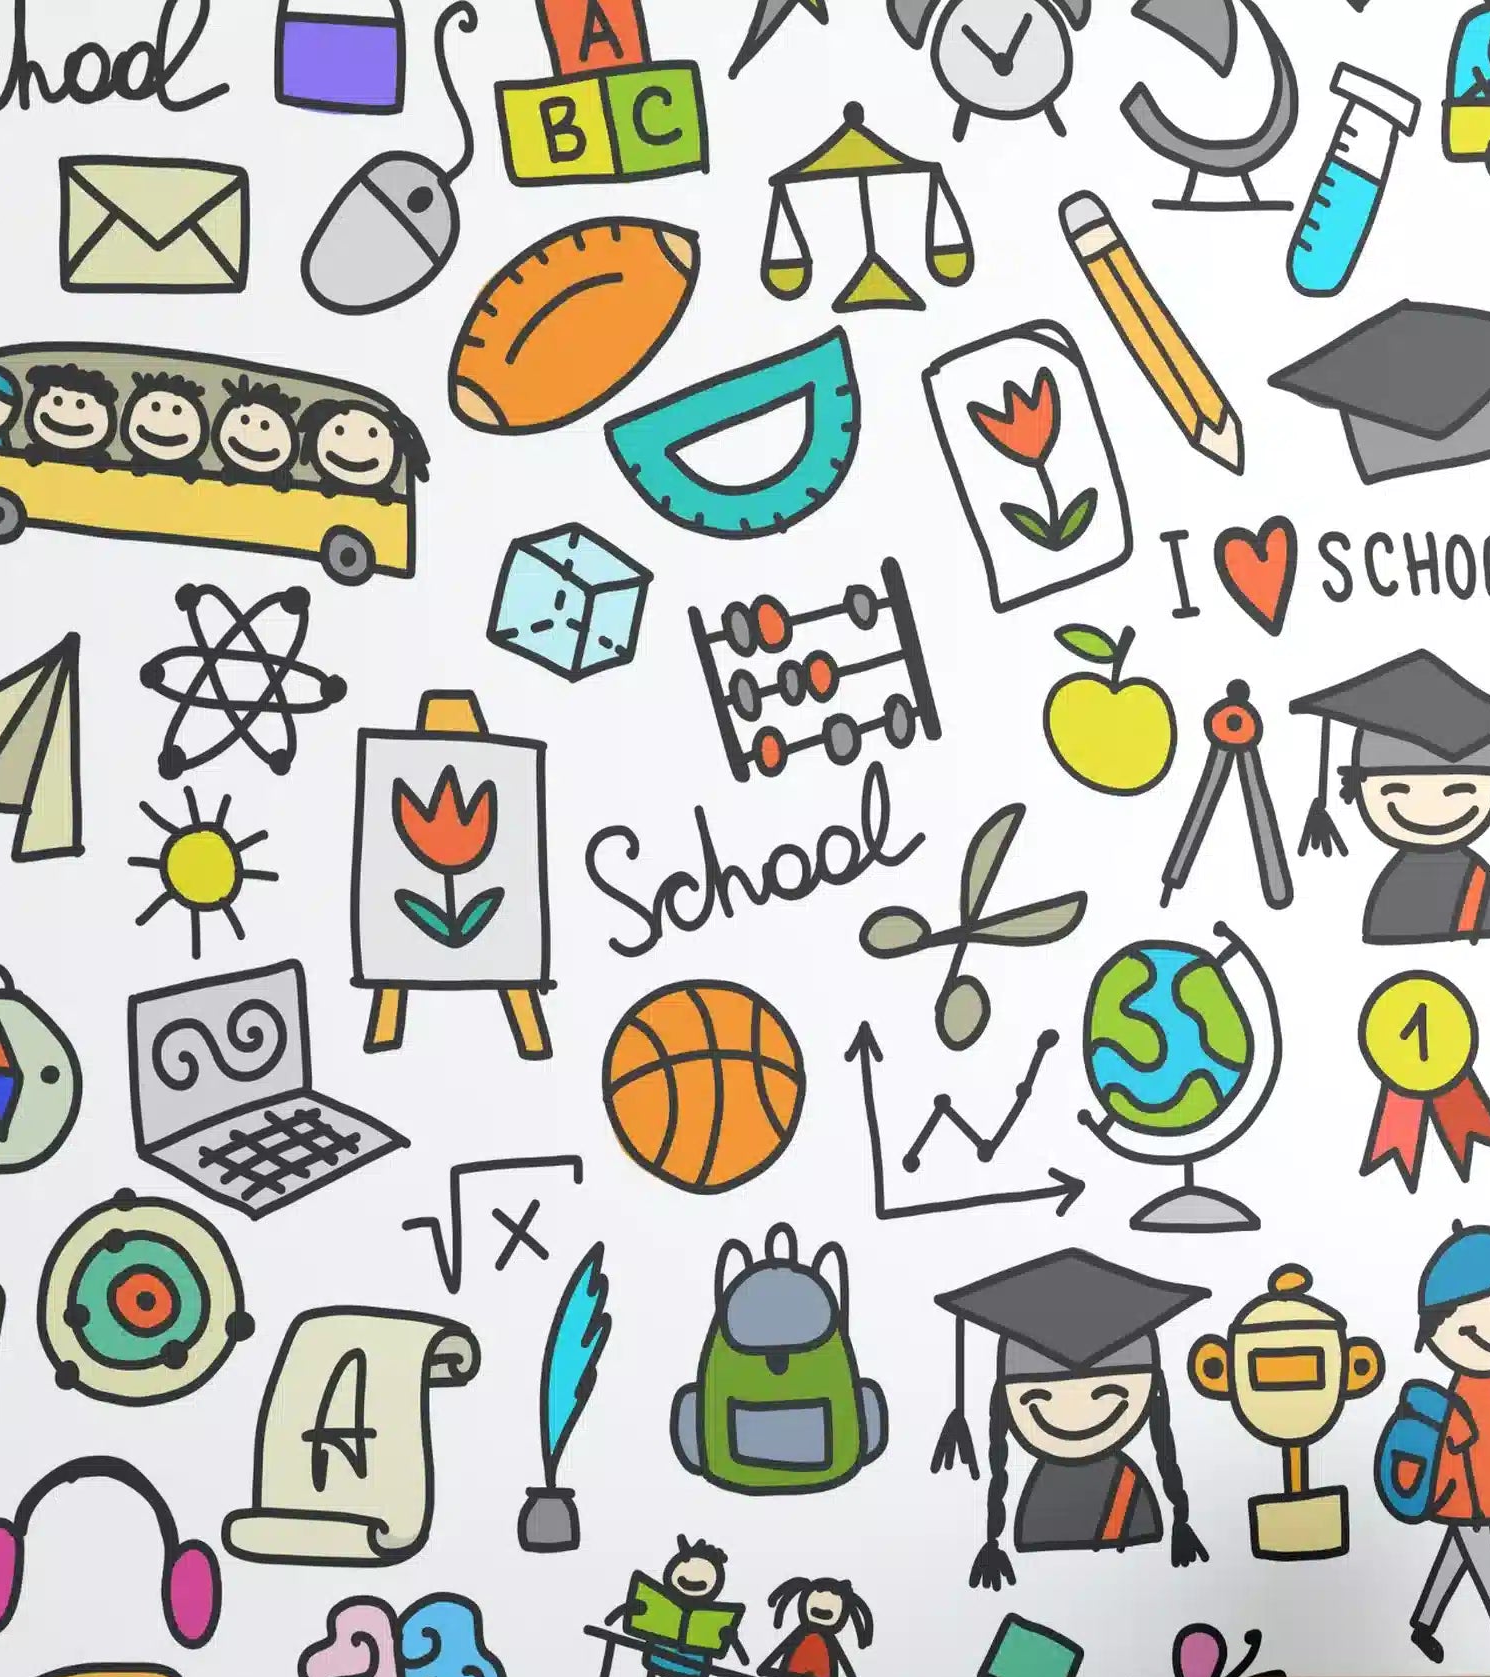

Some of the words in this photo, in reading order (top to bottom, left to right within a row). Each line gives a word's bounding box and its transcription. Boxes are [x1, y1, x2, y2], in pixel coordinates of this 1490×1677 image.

[579, 0, 624, 62] A
[539, 96, 587, 164] B
[632, 85, 683, 146] C
[1159, 529, 1201, 619] I
[585, 760, 926, 958] School
[1399, 1002, 1429, 1062] 1
[301, 1347, 378, 1493] A
